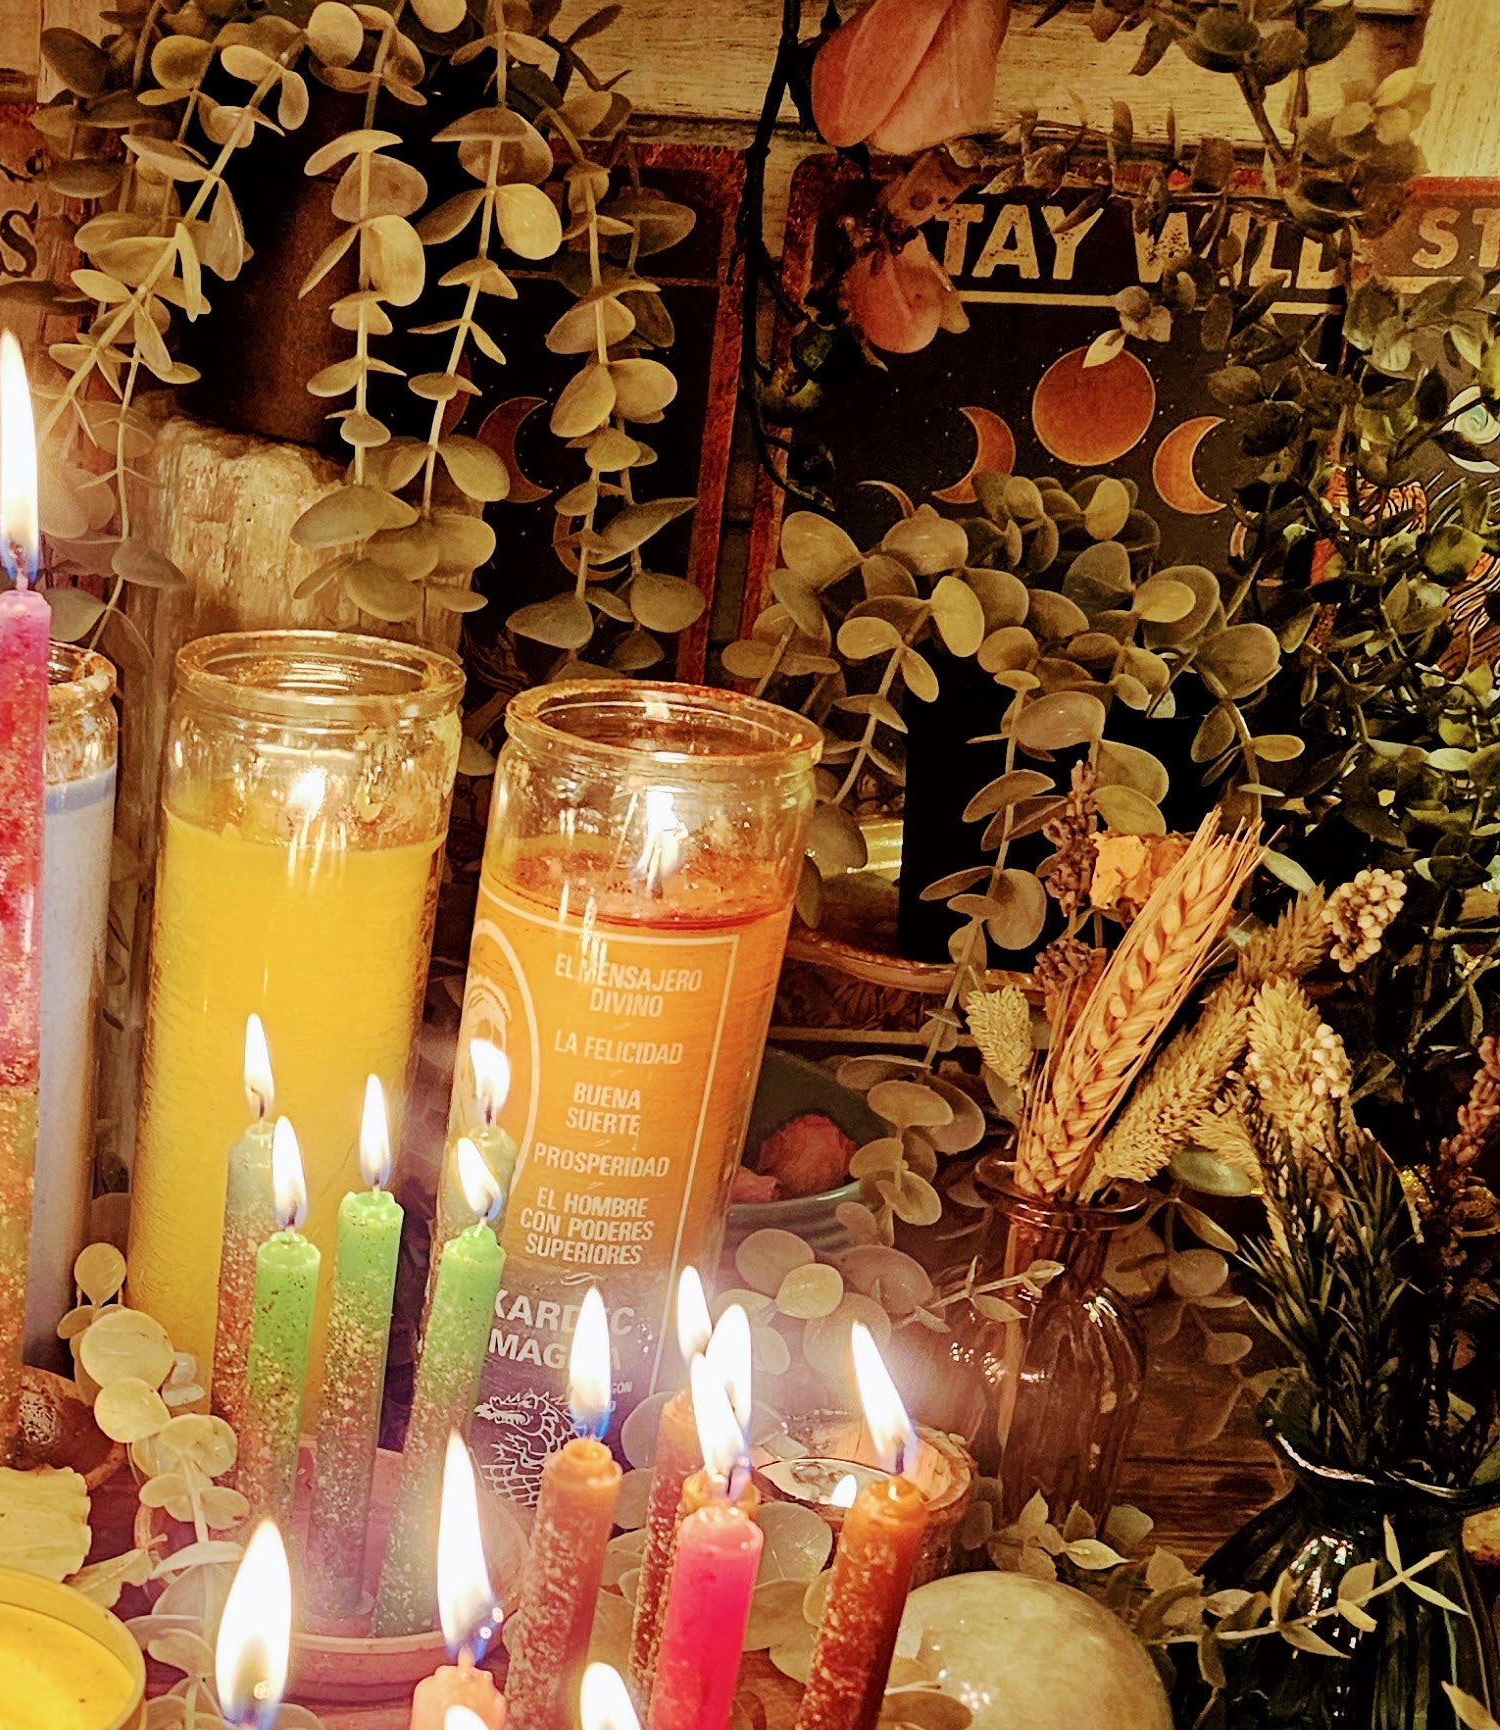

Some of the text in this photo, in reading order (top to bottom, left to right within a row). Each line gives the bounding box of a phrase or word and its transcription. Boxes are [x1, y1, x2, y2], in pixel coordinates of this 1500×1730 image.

[934, 203, 1105, 281] TAY
[554, 953, 703, 993] EL MENSAJERO
[589, 987, 664, 1018] DIVINO
[554, 1028, 684, 1065] LA FELICIDAD
[573, 1081, 642, 1111] BUENA
[565, 1107, 642, 1137] SUERTE
[533, 1142, 671, 1178] PROSPERIDAD
[536, 1185, 649, 1219] EL HOMBRE
[519, 1208, 655, 1242] CON PODERES
[525, 1233, 643, 1266] SUPERIORES
[494, 1288, 636, 1337] KARDC
[487, 1328, 622, 1372] MAG
